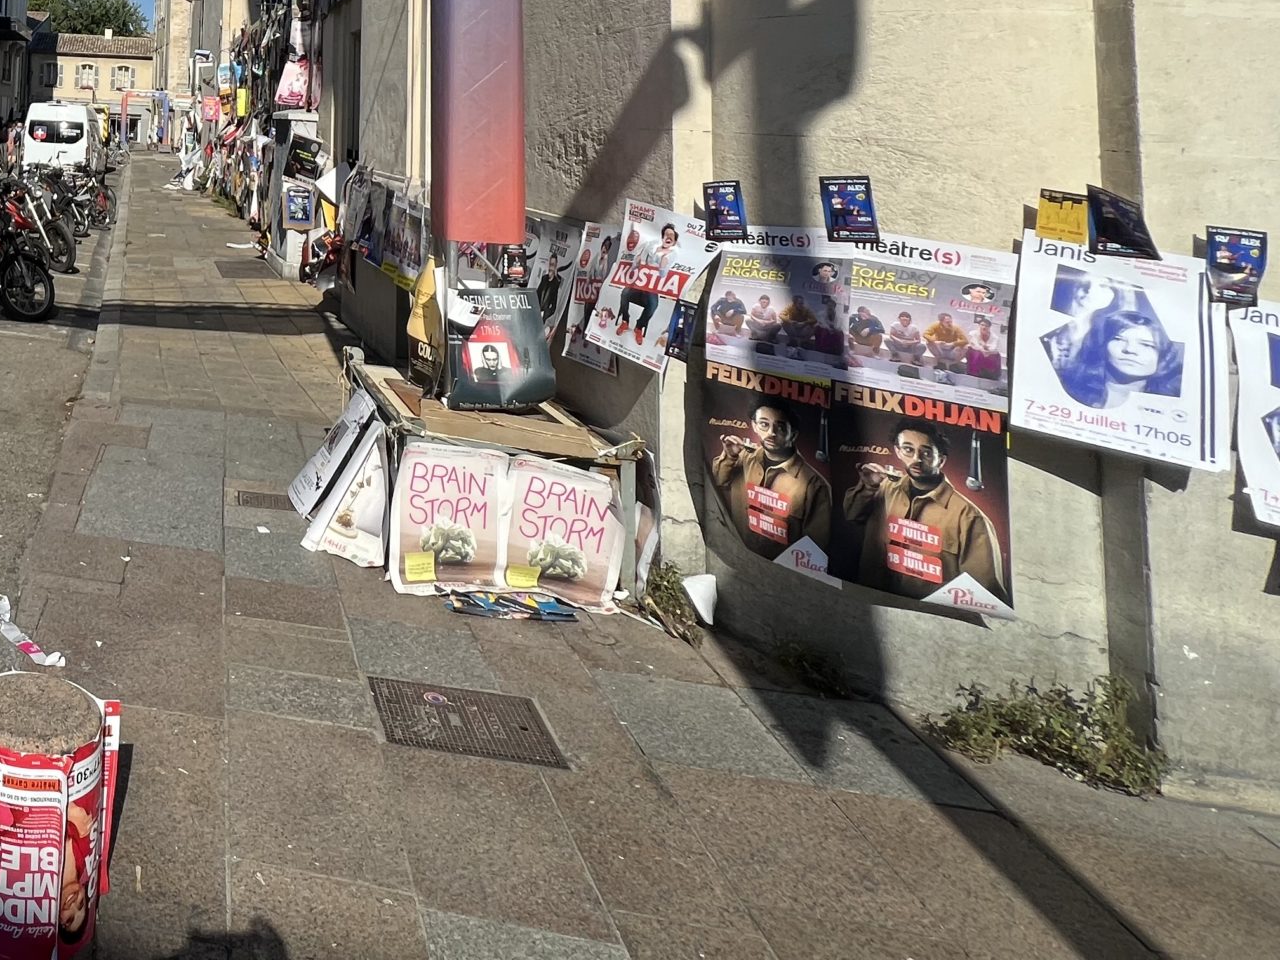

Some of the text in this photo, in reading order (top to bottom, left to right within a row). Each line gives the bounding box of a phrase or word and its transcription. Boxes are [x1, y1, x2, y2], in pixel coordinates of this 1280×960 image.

[725, 257, 760, 269] TOUS
[1034, 238, 1097, 264] Janis
[851, 265, 896, 282] TOUS
[494, 294, 532, 310] EN EXIL
[1076, 410, 1128, 433] Juillet
[1134, 424, 1192, 447] 17h05
[409, 494, 488, 529] STORM
[747, 489, 788, 511] 17 JUILLET
[520, 508, 605, 554] STORM
[759, 520, 787, 537] JUILLET
[889, 522, 939, 546] 17 JUILLET
[888, 552, 942, 576] 18 JUILLET
[947, 587, 998, 611] Palace
